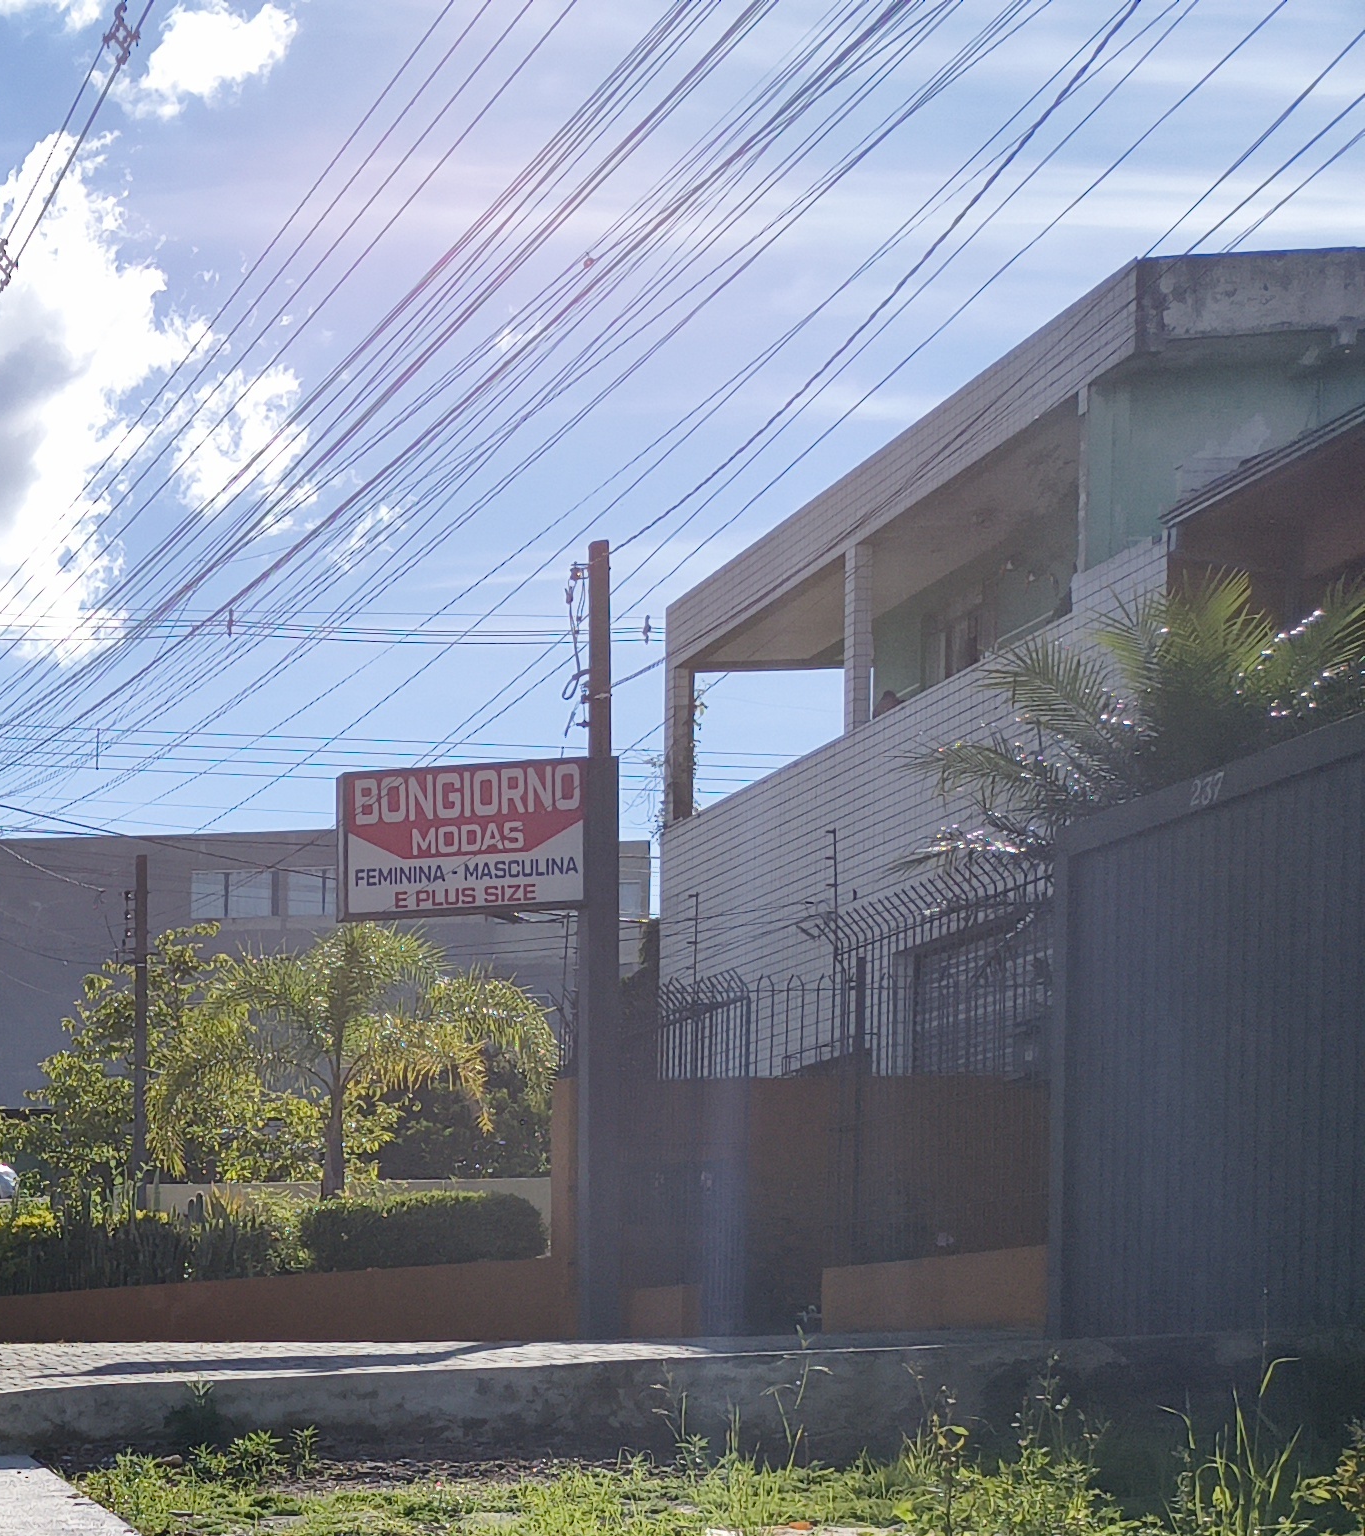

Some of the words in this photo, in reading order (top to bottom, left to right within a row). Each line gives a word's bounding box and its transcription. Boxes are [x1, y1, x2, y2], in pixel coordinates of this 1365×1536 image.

[354, 763, 581, 826] BONGIORNO
[1189, 771, 1225, 806] 237
[411, 821, 524, 856] MODAS
[354, 863, 446, 887] FEMININA
[463, 856, 579, 881] MASCULINA
[394, 891, 409, 910] E
[415, 887, 477, 908] PLUS
[483, 884, 537, 904] SIZE
